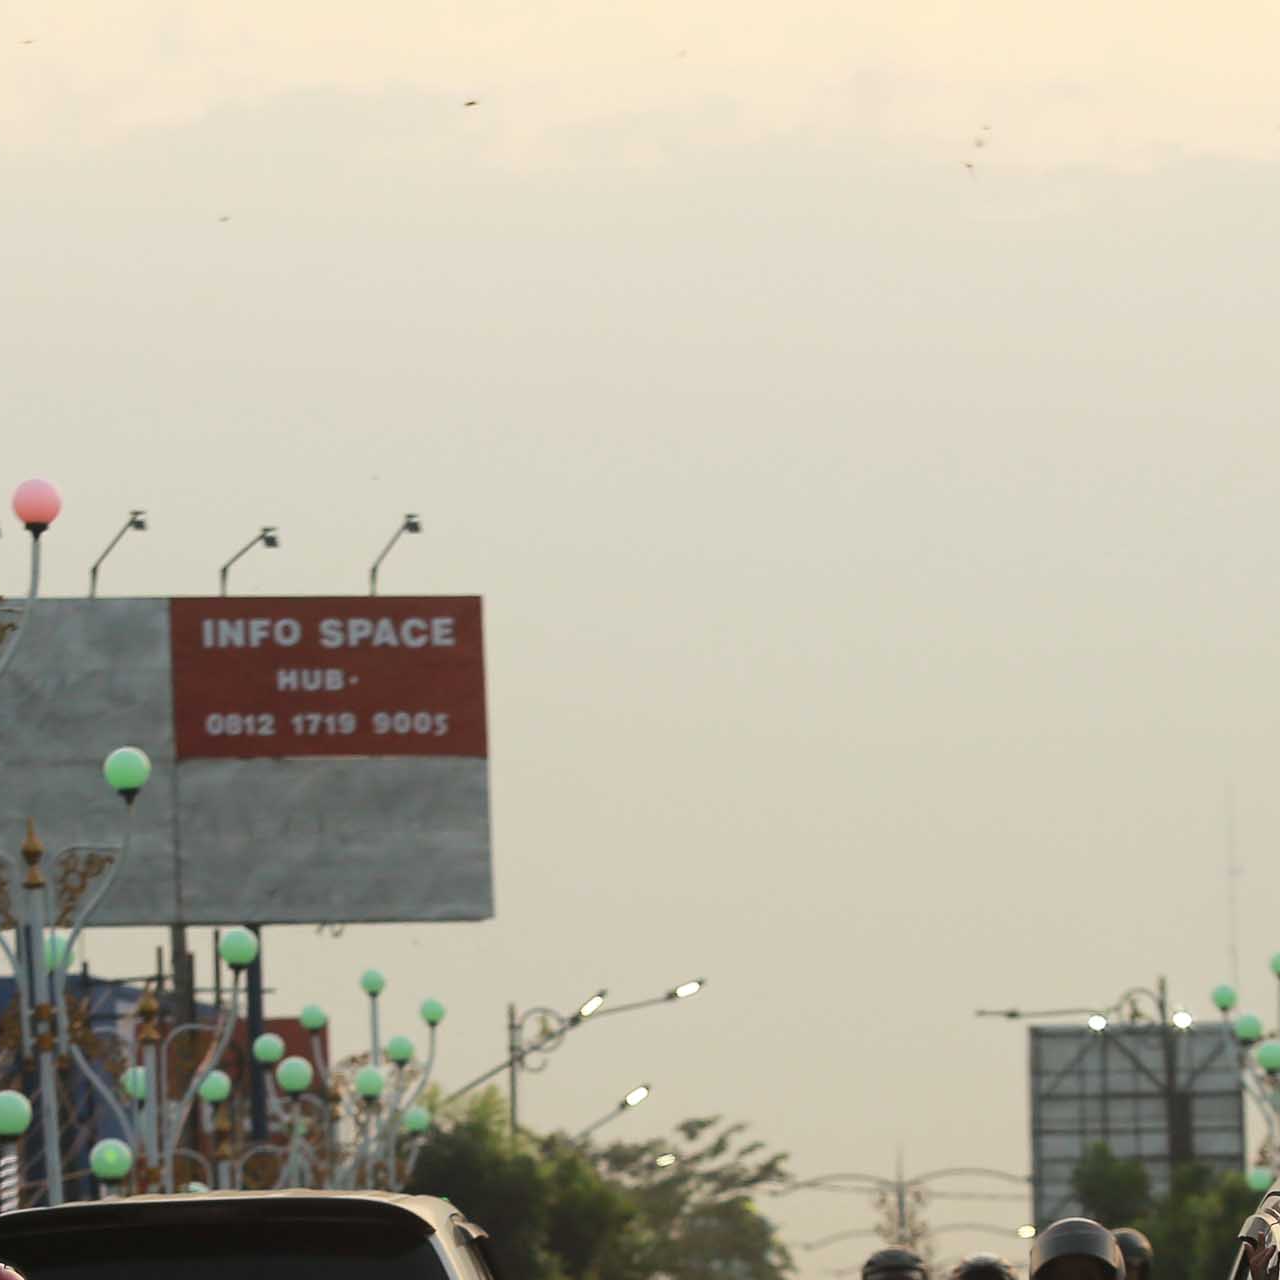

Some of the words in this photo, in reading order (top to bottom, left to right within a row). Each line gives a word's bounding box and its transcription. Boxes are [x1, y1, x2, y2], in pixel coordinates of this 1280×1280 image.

[201, 618, 302, 648] INFO
[318, 617, 456, 648] SPACE
[204, 713, 276, 736] 0812
[291, 712, 356, 736] 1719
[371, 712, 450, 736] 9005
